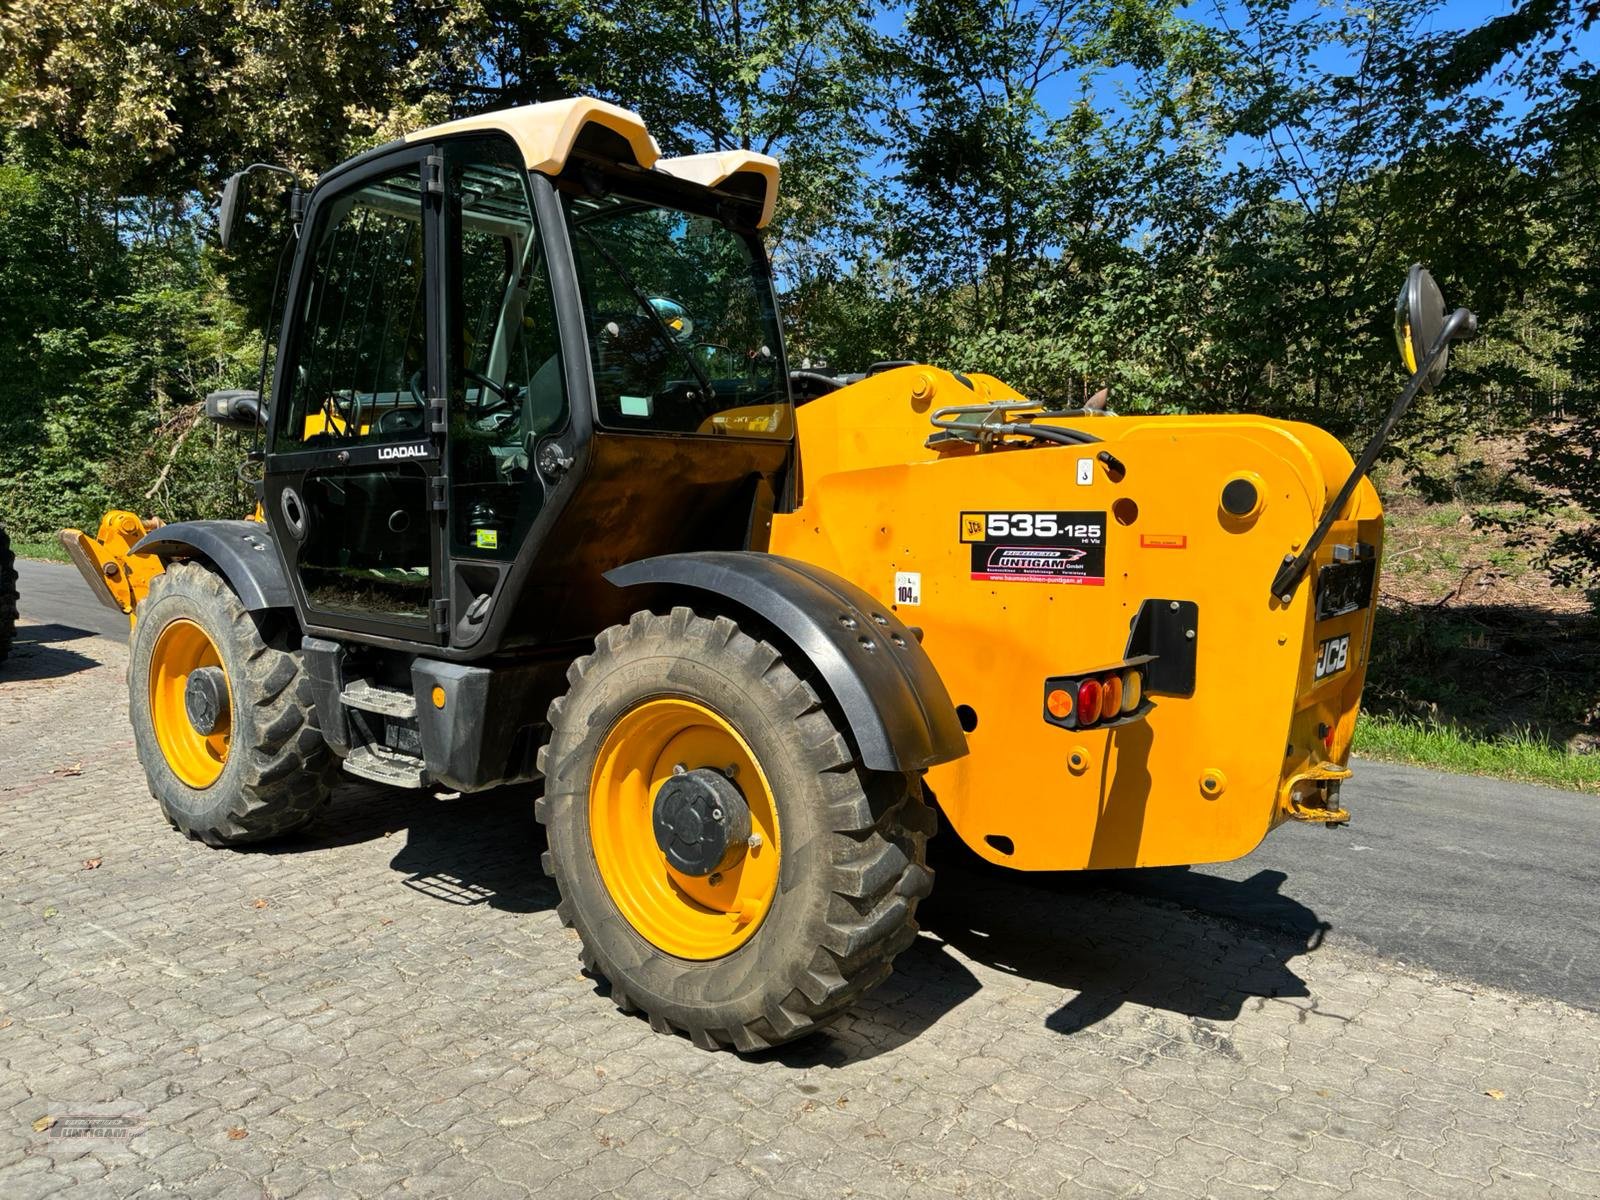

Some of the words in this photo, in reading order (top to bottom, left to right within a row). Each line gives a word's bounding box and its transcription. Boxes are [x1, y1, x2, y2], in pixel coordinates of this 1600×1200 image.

[378, 445, 428, 459] LOADALL
[898, 586, 912, 602] 104
[1316, 636, 1350, 677] JCB
